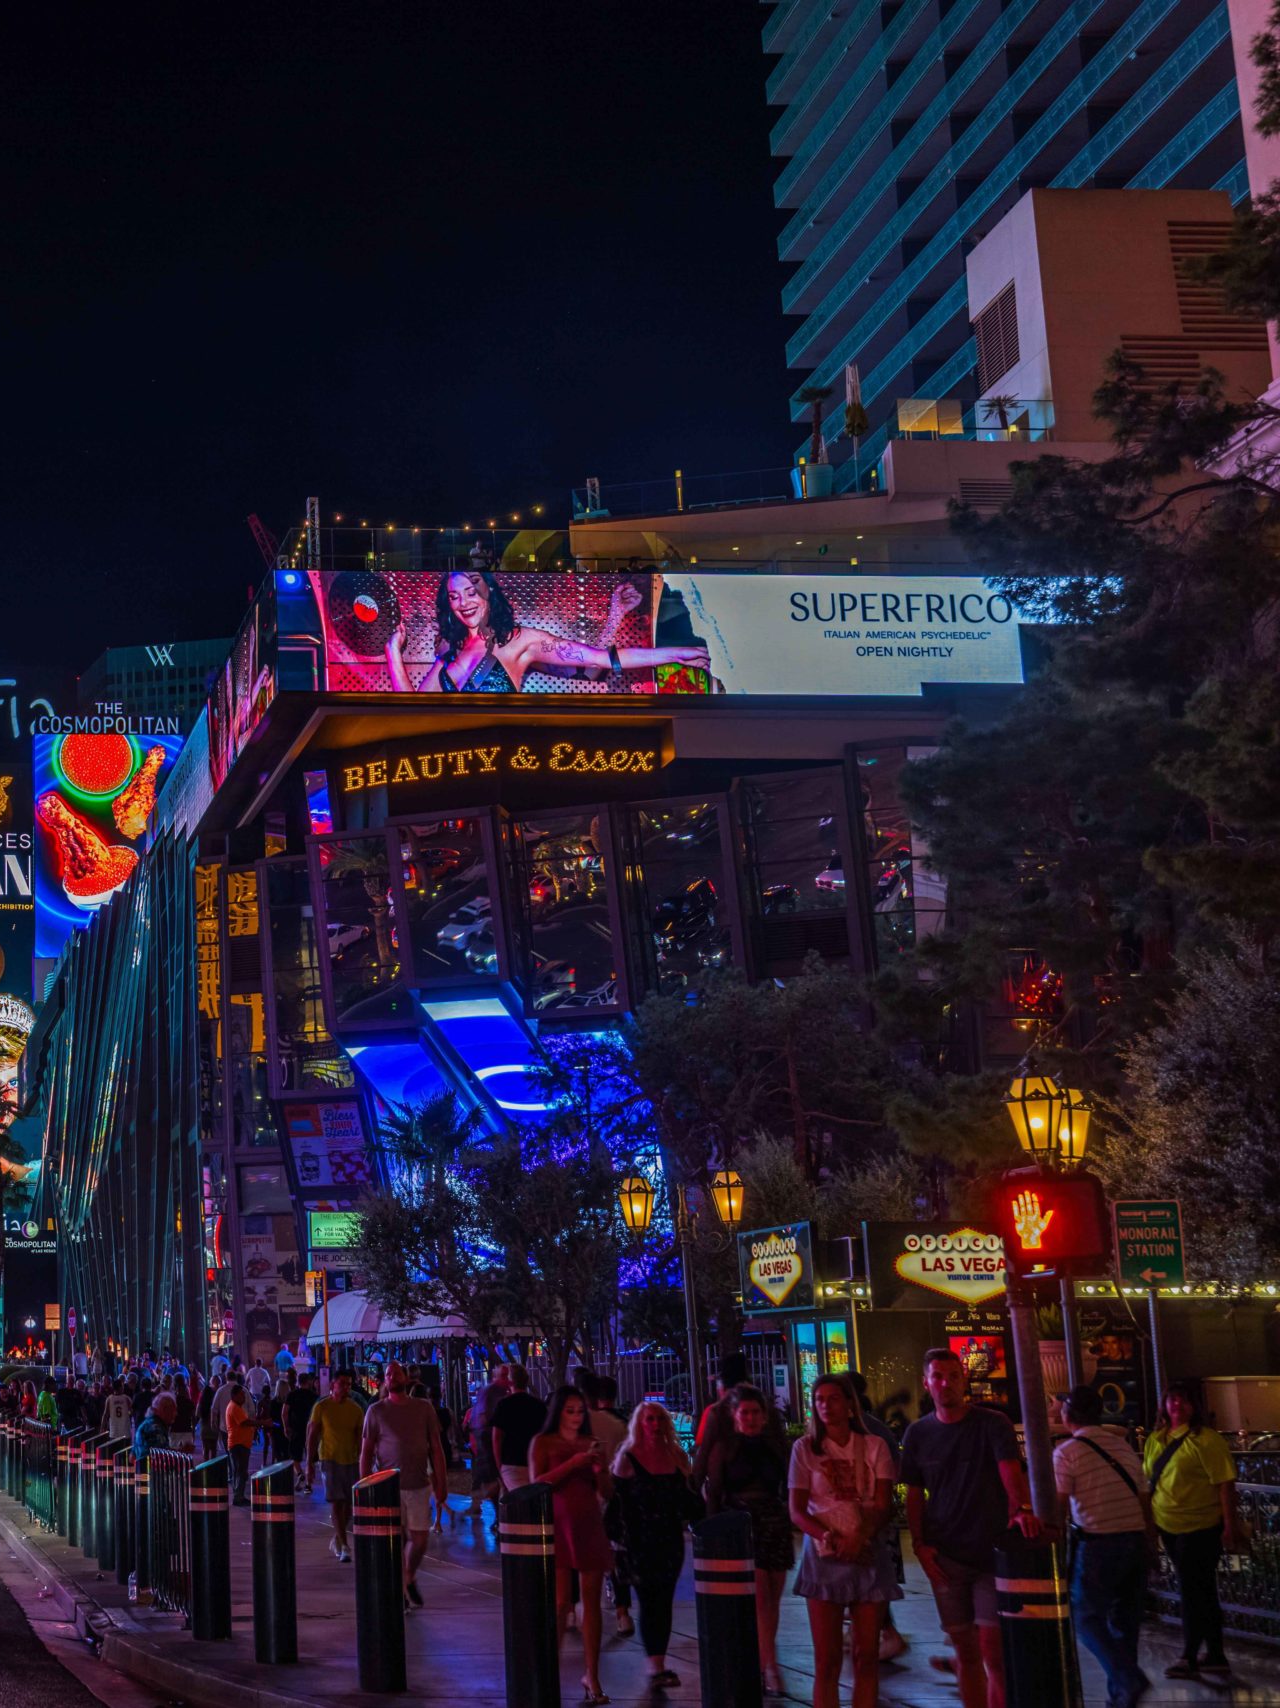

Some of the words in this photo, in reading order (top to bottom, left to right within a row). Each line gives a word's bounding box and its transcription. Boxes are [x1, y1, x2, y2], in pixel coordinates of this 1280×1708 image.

[789, 592, 1014, 624] SUPERFRICO
[823, 630, 861, 639] ITALIAN
[865, 630, 917, 640] AMERICAN
[856, 646, 894, 657] OPEN
[897, 646, 955, 658] NIGHTLY
[95, 702, 124, 714] THE
[38, 716, 180, 735] COSMOPOLITAN
[343, 746, 501, 792] BEAUTY
[510, 745, 541, 770] &
[548, 742, 656, 773] Essex
[1119, 1227, 1177, 1240] MONORAIL
[906, 1235, 1004, 1250] OFFICI
[1126, 1244, 1175, 1257] STATION
[759, 1262, 772, 1277] LAS
[772, 1260, 793, 1276] VEGAS
[921, 1257, 955, 1272] LAS
[959, 1257, 1007, 1272] VEGA
